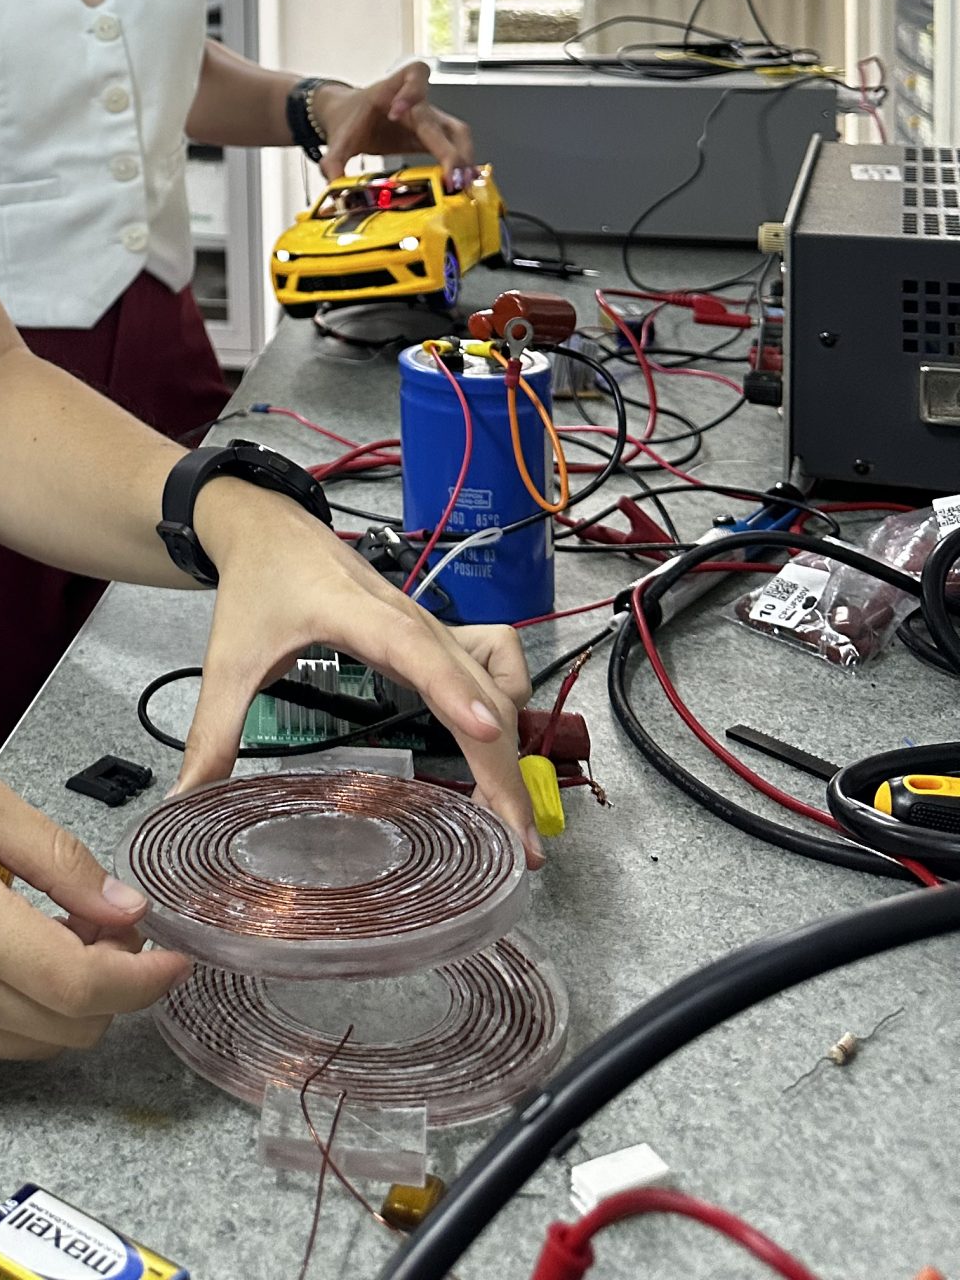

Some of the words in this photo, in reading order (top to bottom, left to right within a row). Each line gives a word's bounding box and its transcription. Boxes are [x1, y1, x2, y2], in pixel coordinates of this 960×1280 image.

[454, 561, 493, 578] POSITIVE
[759, 603, 776, 618] 10
[7, 1208, 118, 1276] maxell
